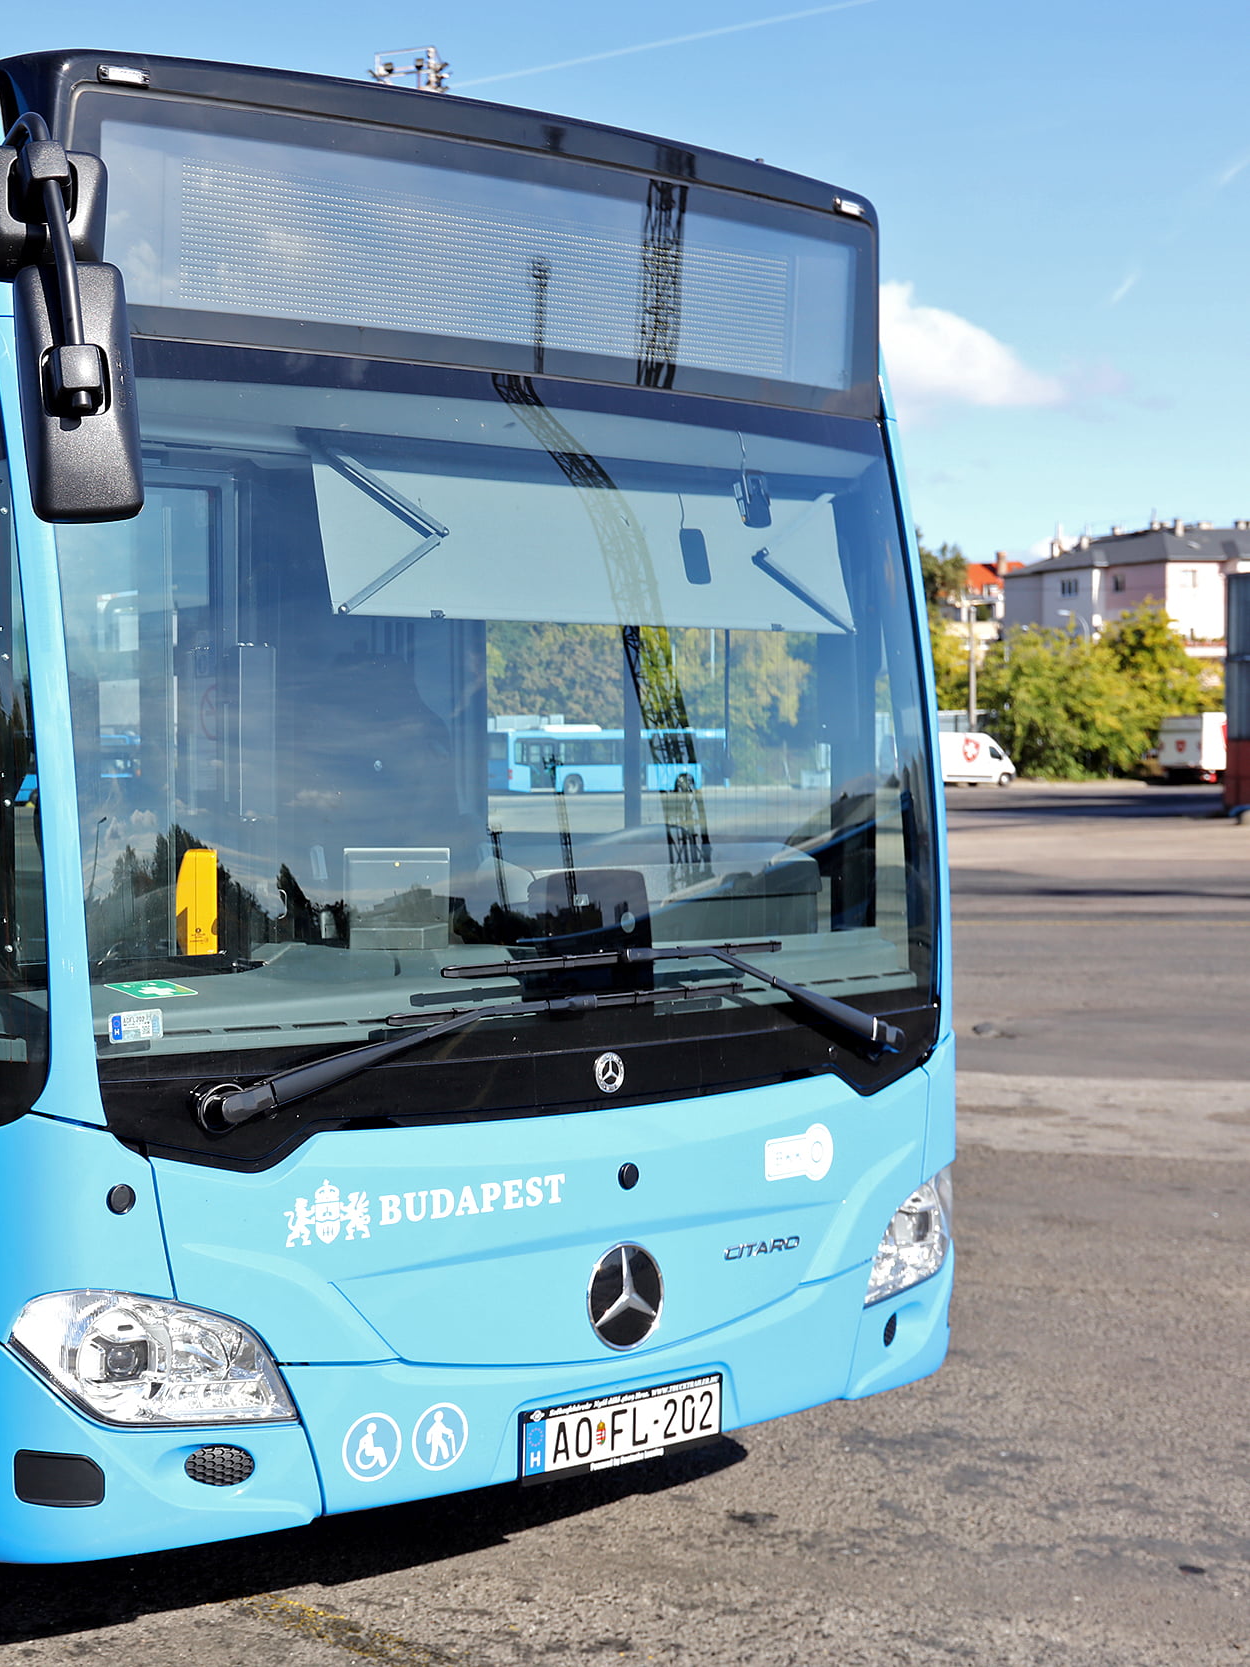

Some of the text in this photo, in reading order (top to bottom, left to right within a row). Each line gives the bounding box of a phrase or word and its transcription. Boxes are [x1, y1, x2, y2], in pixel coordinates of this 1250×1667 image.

[379, 1173, 566, 1226] BUDAPEST
[724, 1235, 800, 1261] CITARO
[529, 1450, 541, 1468] H
